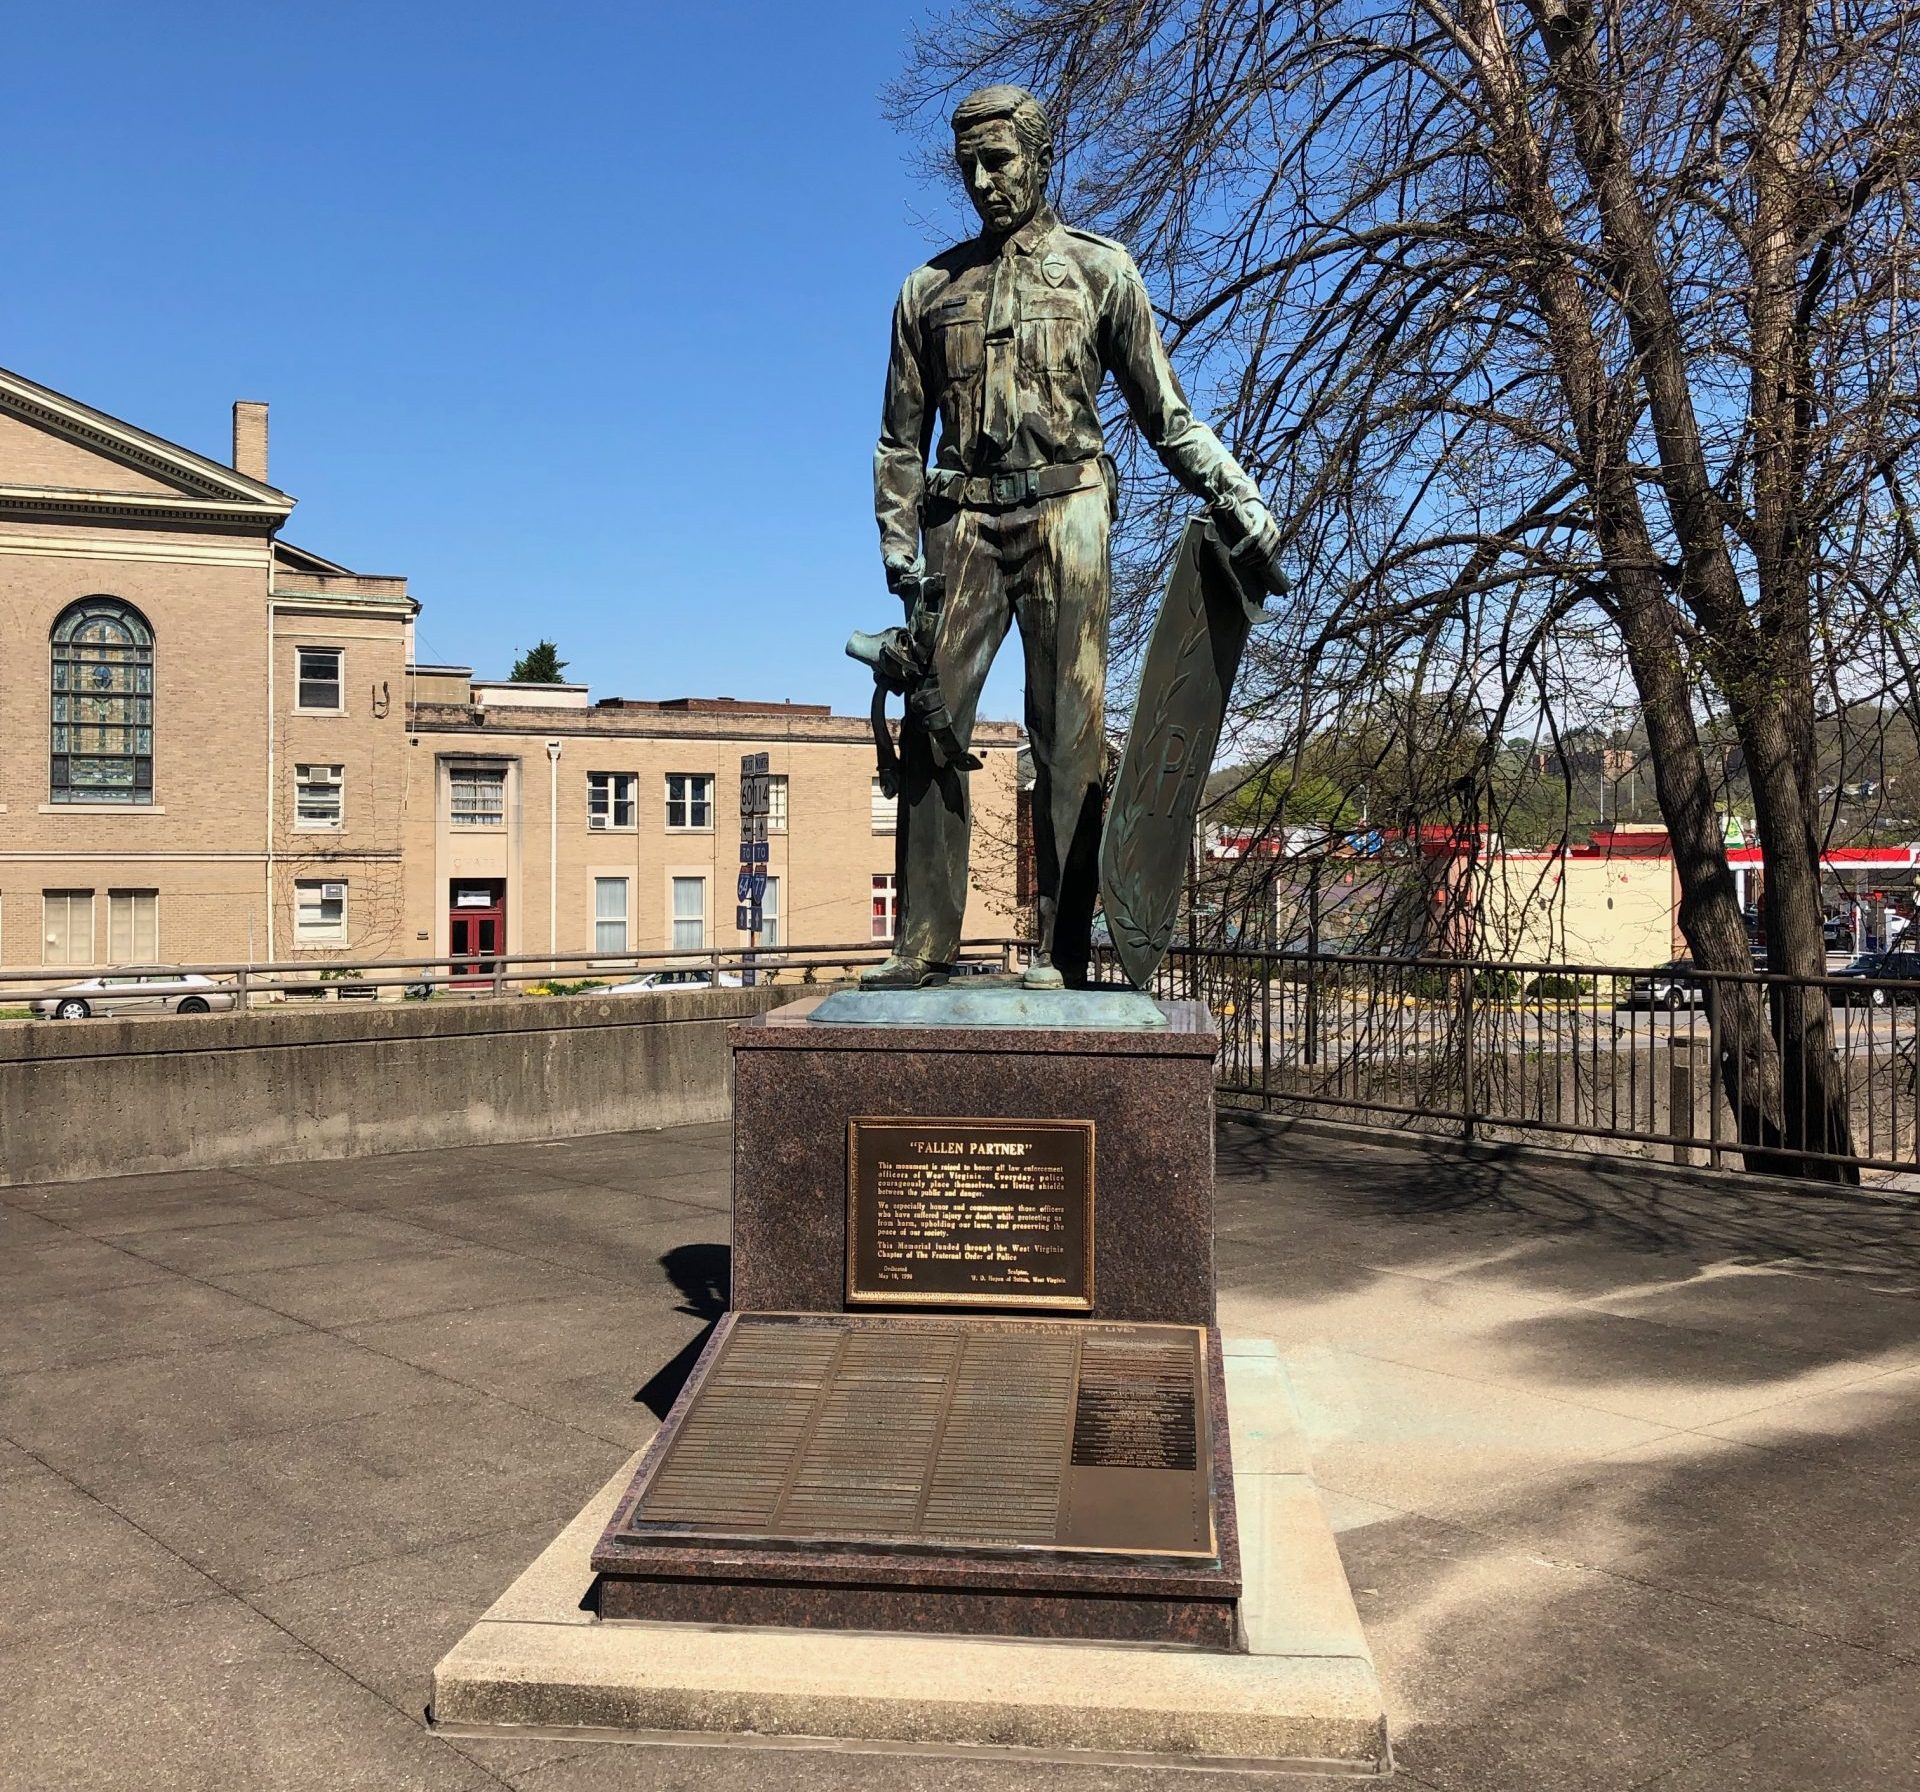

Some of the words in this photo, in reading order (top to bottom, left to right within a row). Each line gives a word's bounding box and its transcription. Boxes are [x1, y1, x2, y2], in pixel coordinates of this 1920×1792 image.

[742, 784, 753, 805] 60
[754, 784, 768, 805] 114
[743, 848, 751, 859] TO
[757, 847, 765, 858] TO
[739, 879, 749, 895] 64
[755, 878, 765, 895] 77
[973, 1163, 993, 1171] honor
[925, 1171, 944, 1179] West
[1039, 1174, 1064, 1182] police
[878, 1180, 925, 1188] courageously
[930, 1180, 949, 1188] place
[1012, 1181, 1034, 1191] living
[1038, 1182, 1064, 1190] shields
[908, 1188, 917, 1196] the
[921, 1189, 941, 1197] public
[878, 1201, 888, 1209] We
[893, 1202, 925, 1210] especially
[929, 1202, 948, 1210] honor
[1018, 1204, 1036, 1212] those
[878, 1210, 891, 1218] who
[894, 1210, 910, 1218] have
[942, 1212, 962, 1220] injury
[975, 1212, 993, 1220] death
[1018, 1214, 1050, 1222] protecting
[921, 1220, 955, 1229] upholding
[996, 1221, 1009, 1229] and
[1012, 1223, 1049, 1231] preserving
[878, 1241, 893, 1249] This
[897, 1242, 931, 1250] Memorial
[935, 1242, 959, 1250] funded
[964, 1243, 991, 1252] through
[996, 1244, 1007, 1252] the
[1012, 1244, 1030, 1252] West
[1034, 1245, 1064, 1254] Virginia
[878, 1250, 902, 1259] Chapter
[931, 1251, 961, 1259] Fraternal
[964, 1252, 983, 1260] Order
[986, 1252, 993, 1260] of
[1105, 1326, 1136, 1334] LIVES
